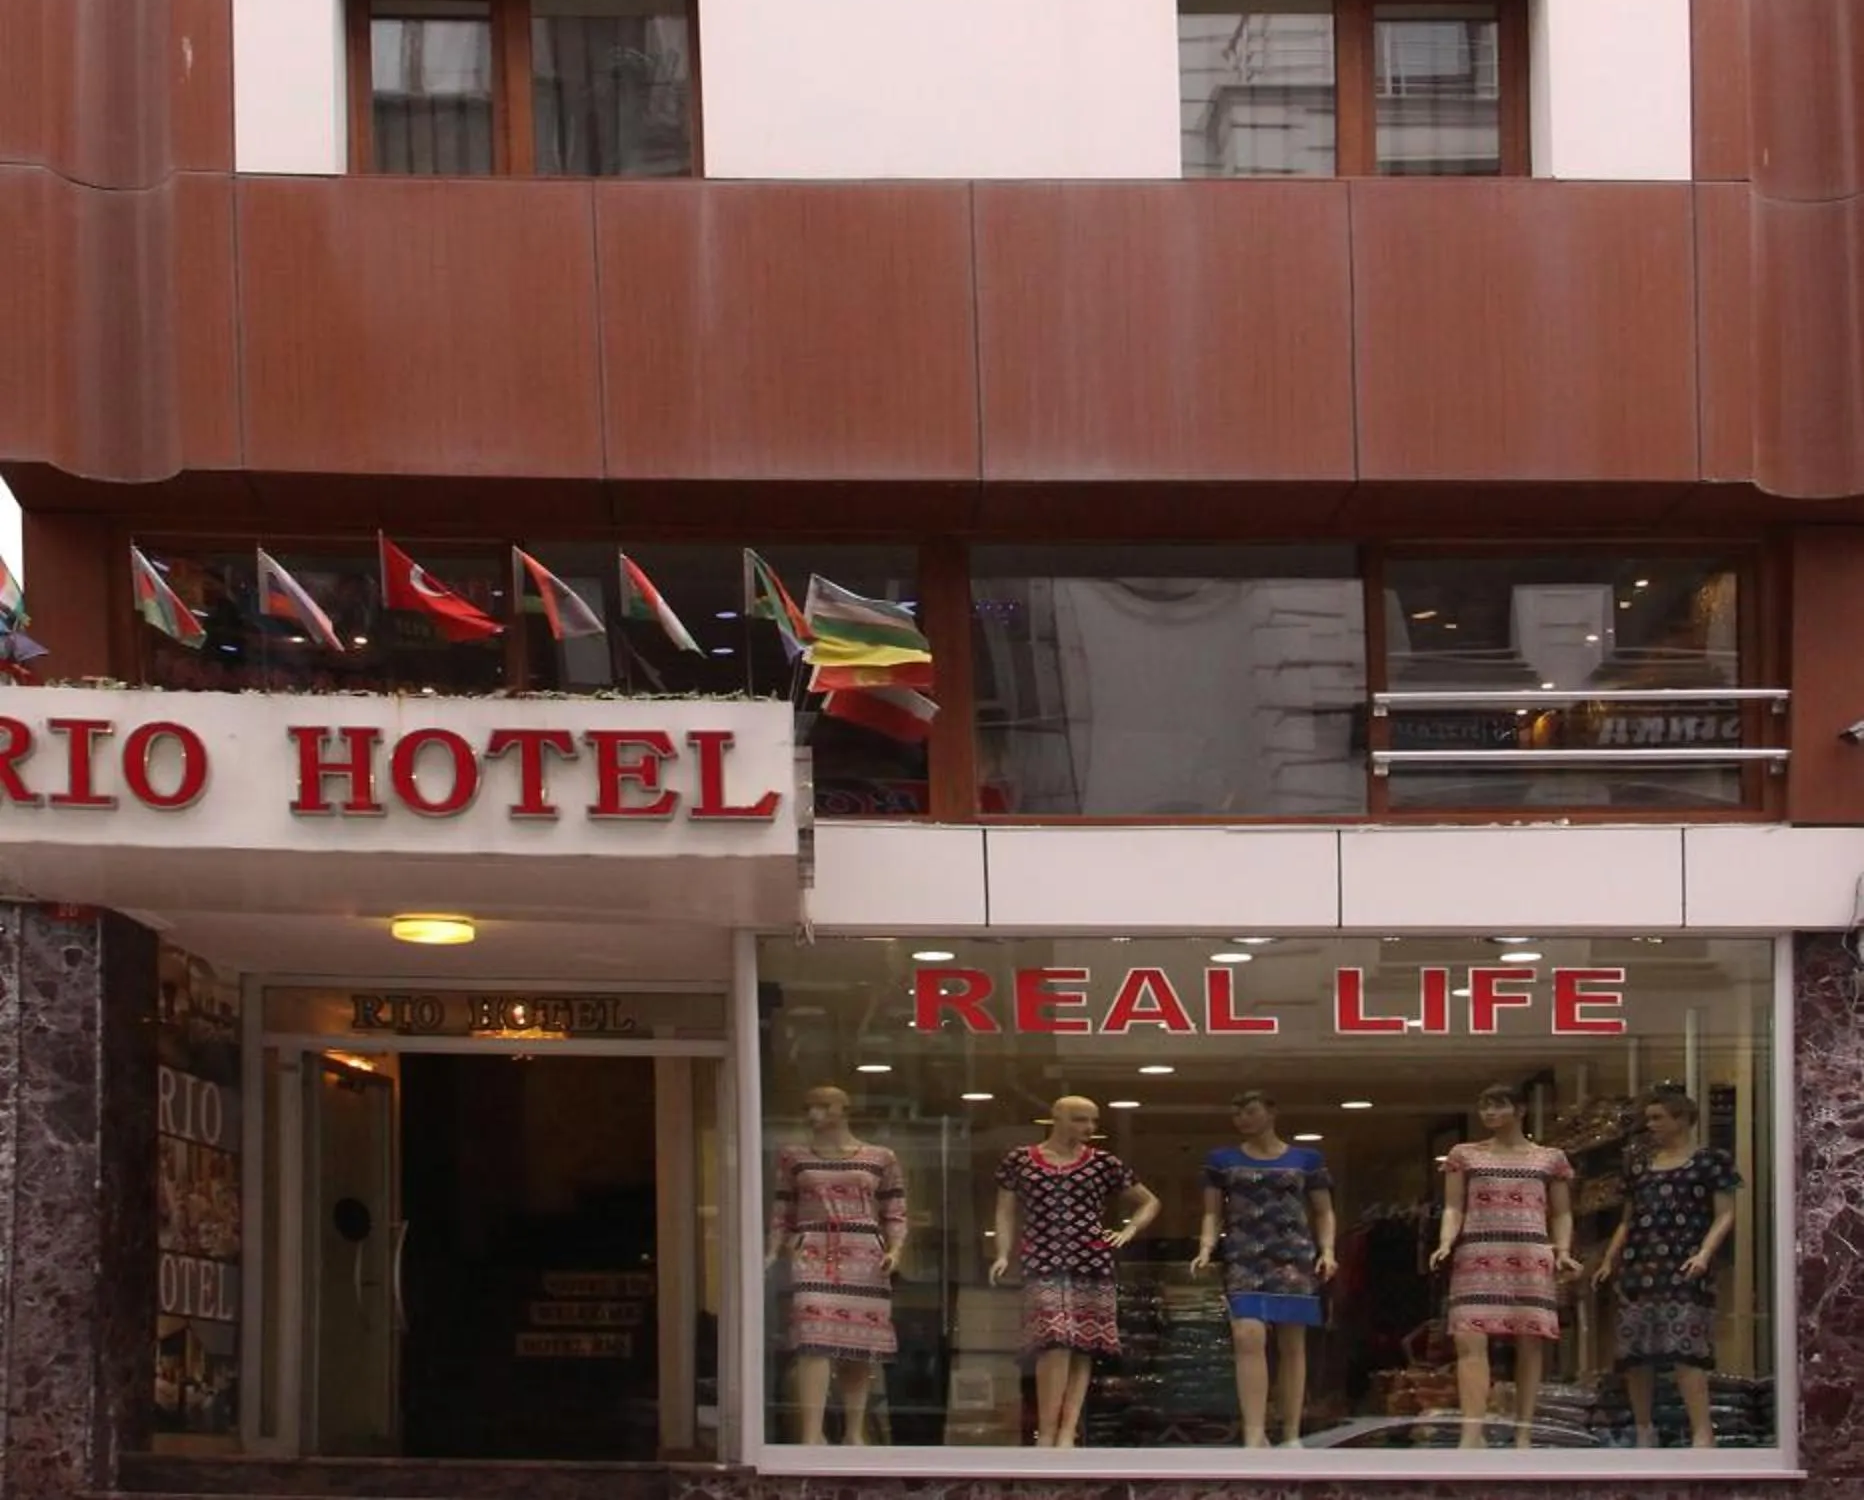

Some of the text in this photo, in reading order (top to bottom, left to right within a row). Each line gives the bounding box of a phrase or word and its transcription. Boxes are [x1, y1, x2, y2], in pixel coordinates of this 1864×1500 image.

[0, 716, 781, 821] RIO HOTEL
[353, 995, 633, 1032] RIO HOTEL
[913, 967, 1627, 1035] REAL LIFE
[158, 1066, 221, 1144] RIO
